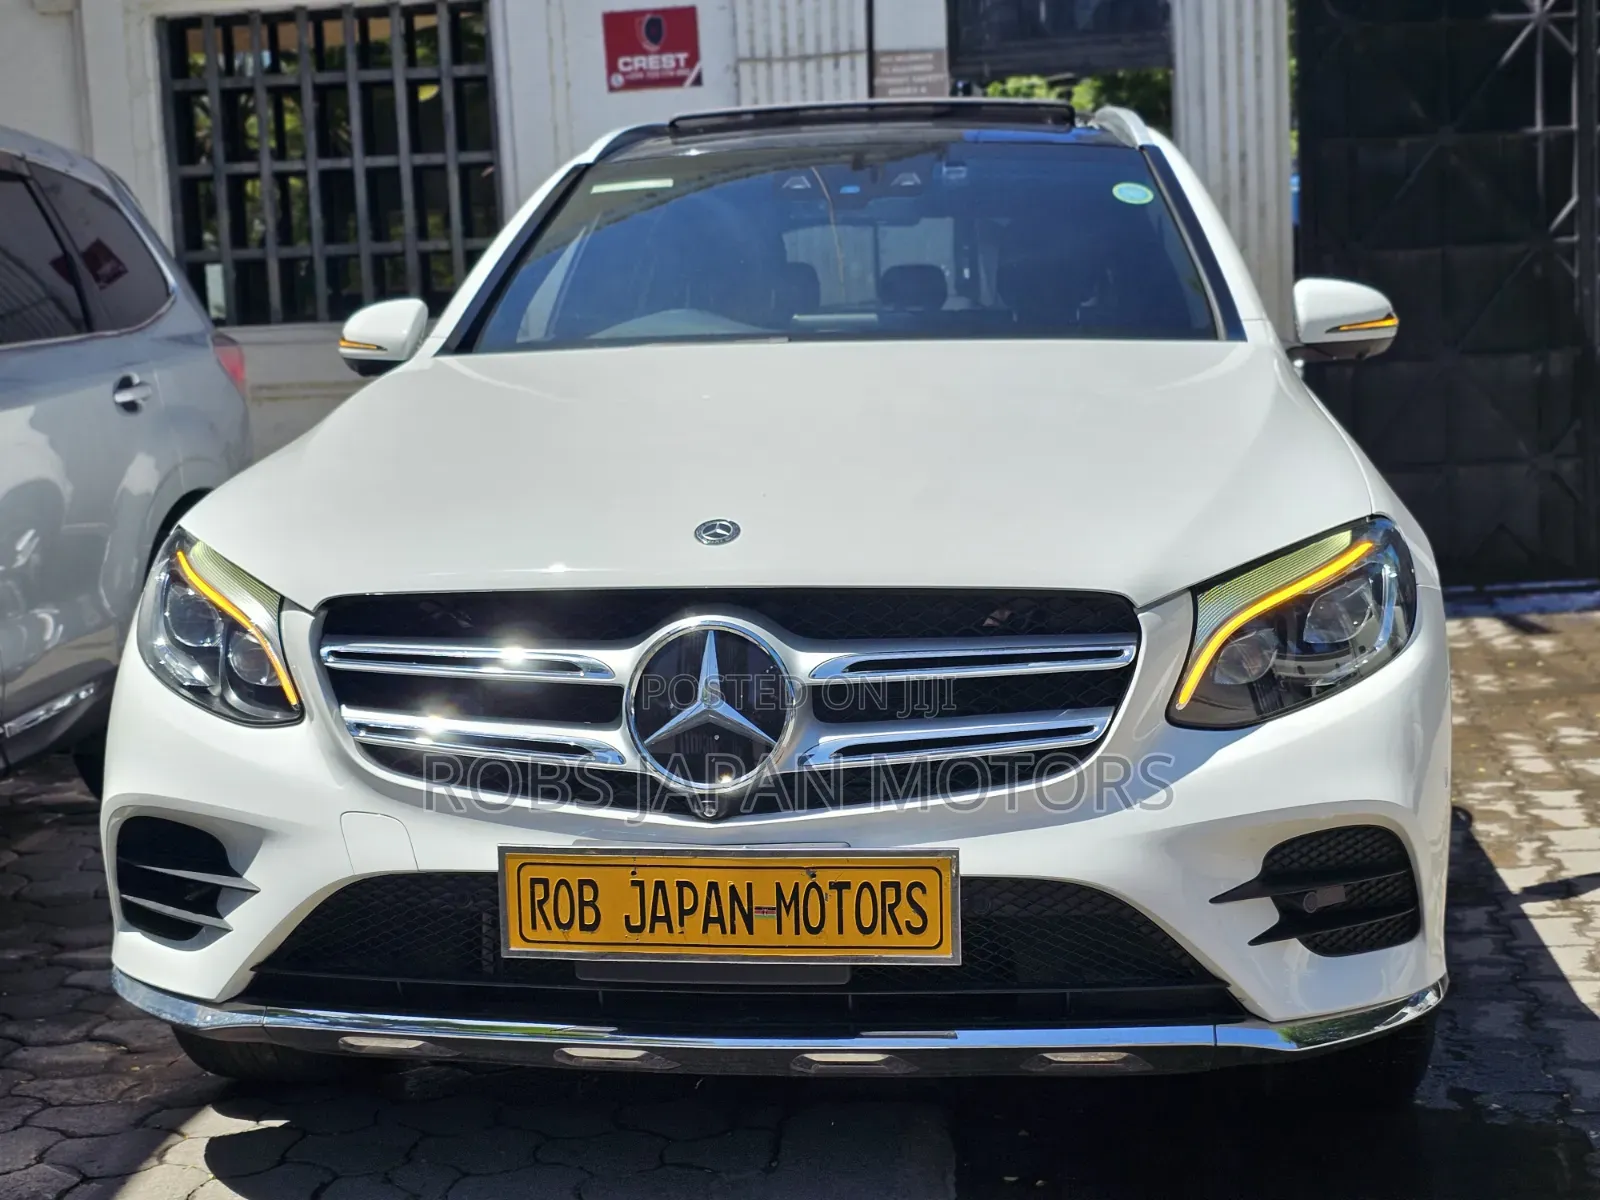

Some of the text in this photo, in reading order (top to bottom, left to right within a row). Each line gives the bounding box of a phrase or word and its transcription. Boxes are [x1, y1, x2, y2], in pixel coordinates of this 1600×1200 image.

[618, 52, 689, 72] CREST
[529, 877, 928, 936] ROB JAPAN MOTORS
